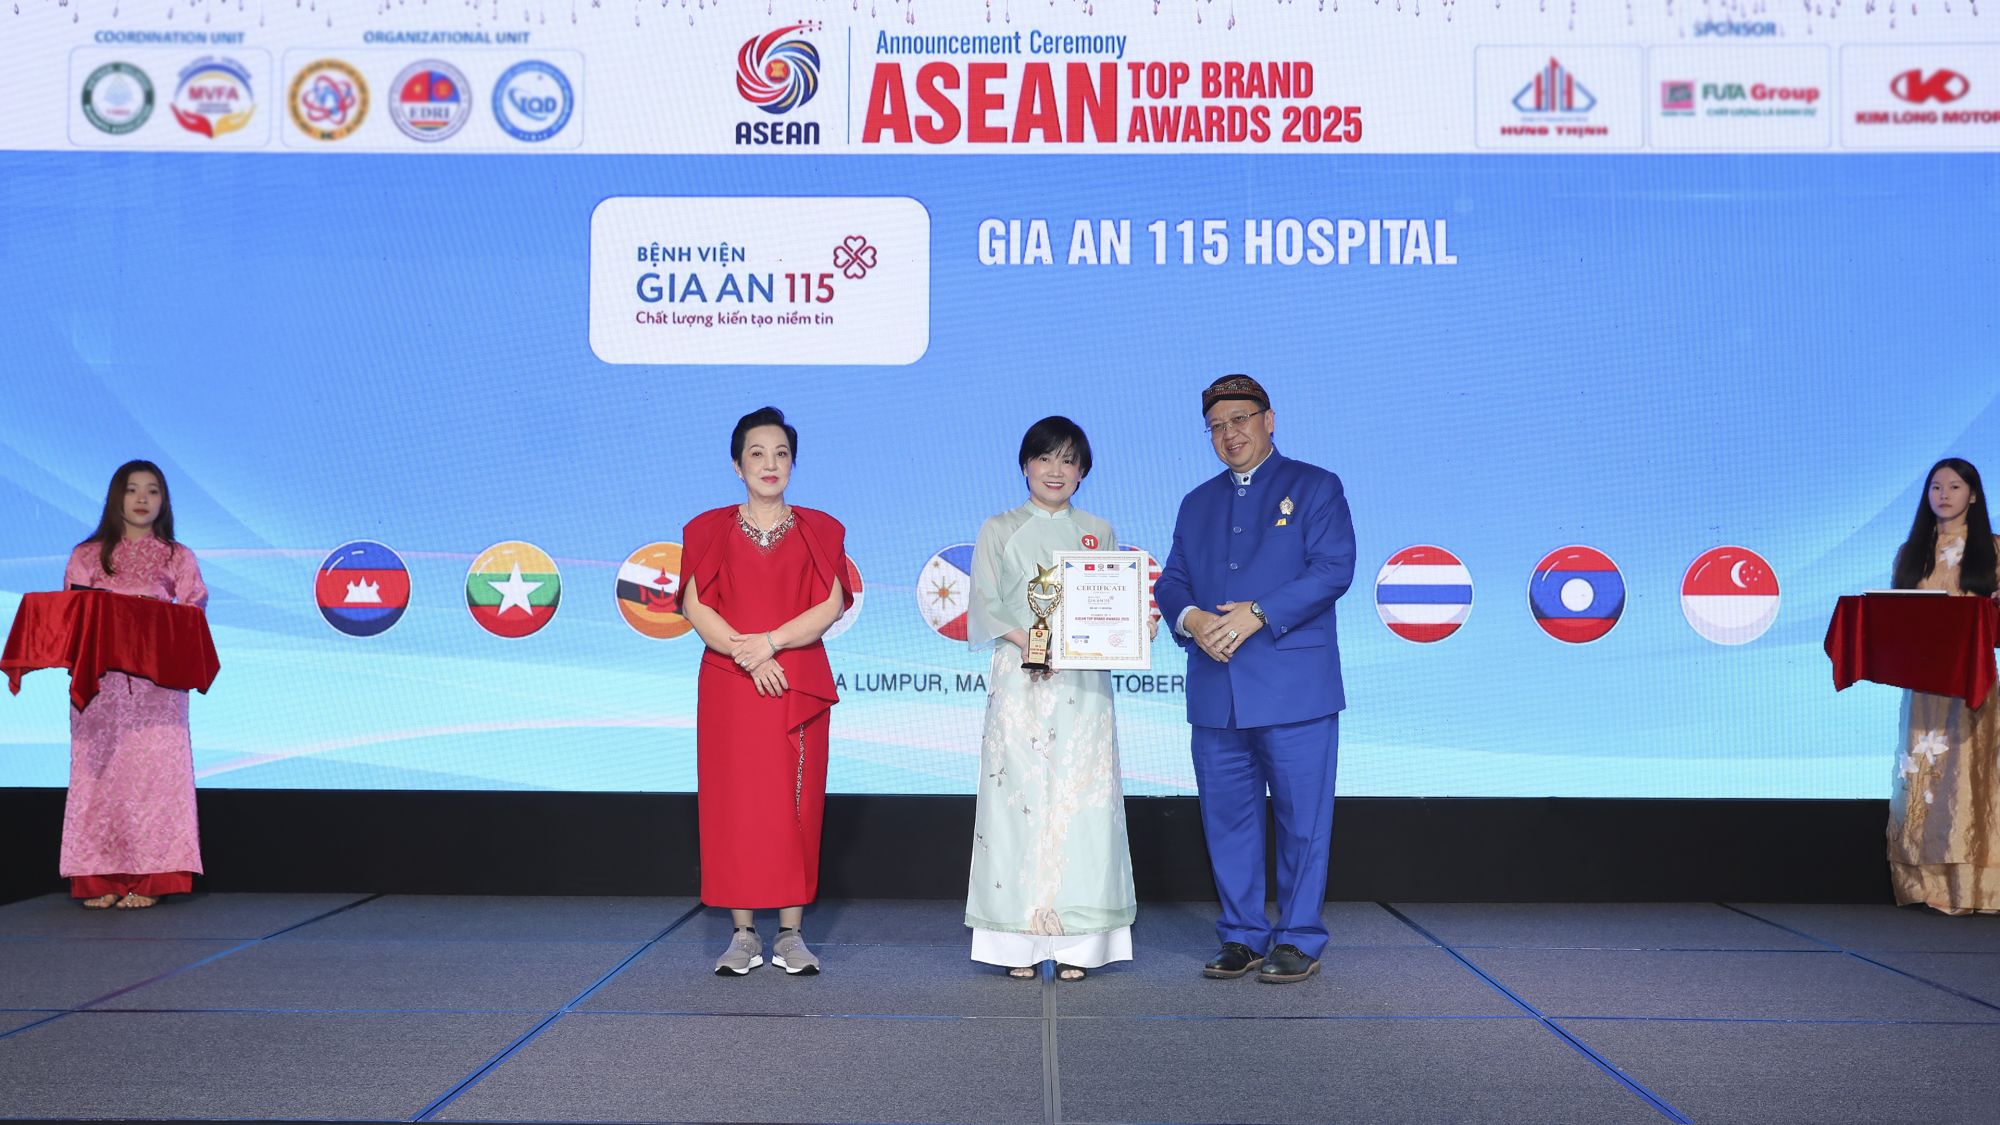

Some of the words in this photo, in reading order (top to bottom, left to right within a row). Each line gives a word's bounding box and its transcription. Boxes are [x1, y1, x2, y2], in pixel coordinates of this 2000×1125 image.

[94, 30, 207, 44] COORDINATION
[210, 31, 245, 44] UNIT
[363, 30, 491, 44] ORGANIZATIONAL
[495, 31, 530, 44] UNIT
[1694, 21, 1777, 37] SPONSOR
[876, 30, 1022, 54] Announcement
[1029, 29, 1127, 60] Ceremony
[188, 86, 239, 100] MVFA
[862, 61, 1118, 144] ASEAN
[1128, 62, 1190, 99] TOP
[1201, 61, 1314, 99] BRAND
[1702, 84, 1746, 100] FUTA
[1750, 83, 1820, 104] Group
[1127, 105, 1271, 143] AWARDS
[1282, 105, 1363, 143] 2025
[1856, 111, 1889, 124] KIM
[1893, 111, 1938, 124] LONG
[736, 121, 820, 145] ASEAN
[978, 218, 1054, 266] GIA
[1067, 219, 1131, 265] AN
[1147, 219, 1229, 266] 115
[1244, 218, 1458, 266] HOSPITAL
[637, 242, 691, 267] BỆNH
[697, 242, 745, 267] VIỆN
[636, 273, 708, 303] GIA
[715, 273, 774, 303] AN
[785, 273, 835, 304] 115
[636, 311, 668, 325] Chất
[672, 311, 713, 327] lượng
[718, 310, 748, 325] kiến
[751, 314, 773, 327] tạo
[815, 312, 833, 325] tin
[1085, 538, 1095, 547] 31
[836, 673, 847, 691] A
[855, 673, 948, 694] LUMPUR,
[956, 674, 987, 692] MA
[1112, 674, 1185, 693] TOBER
